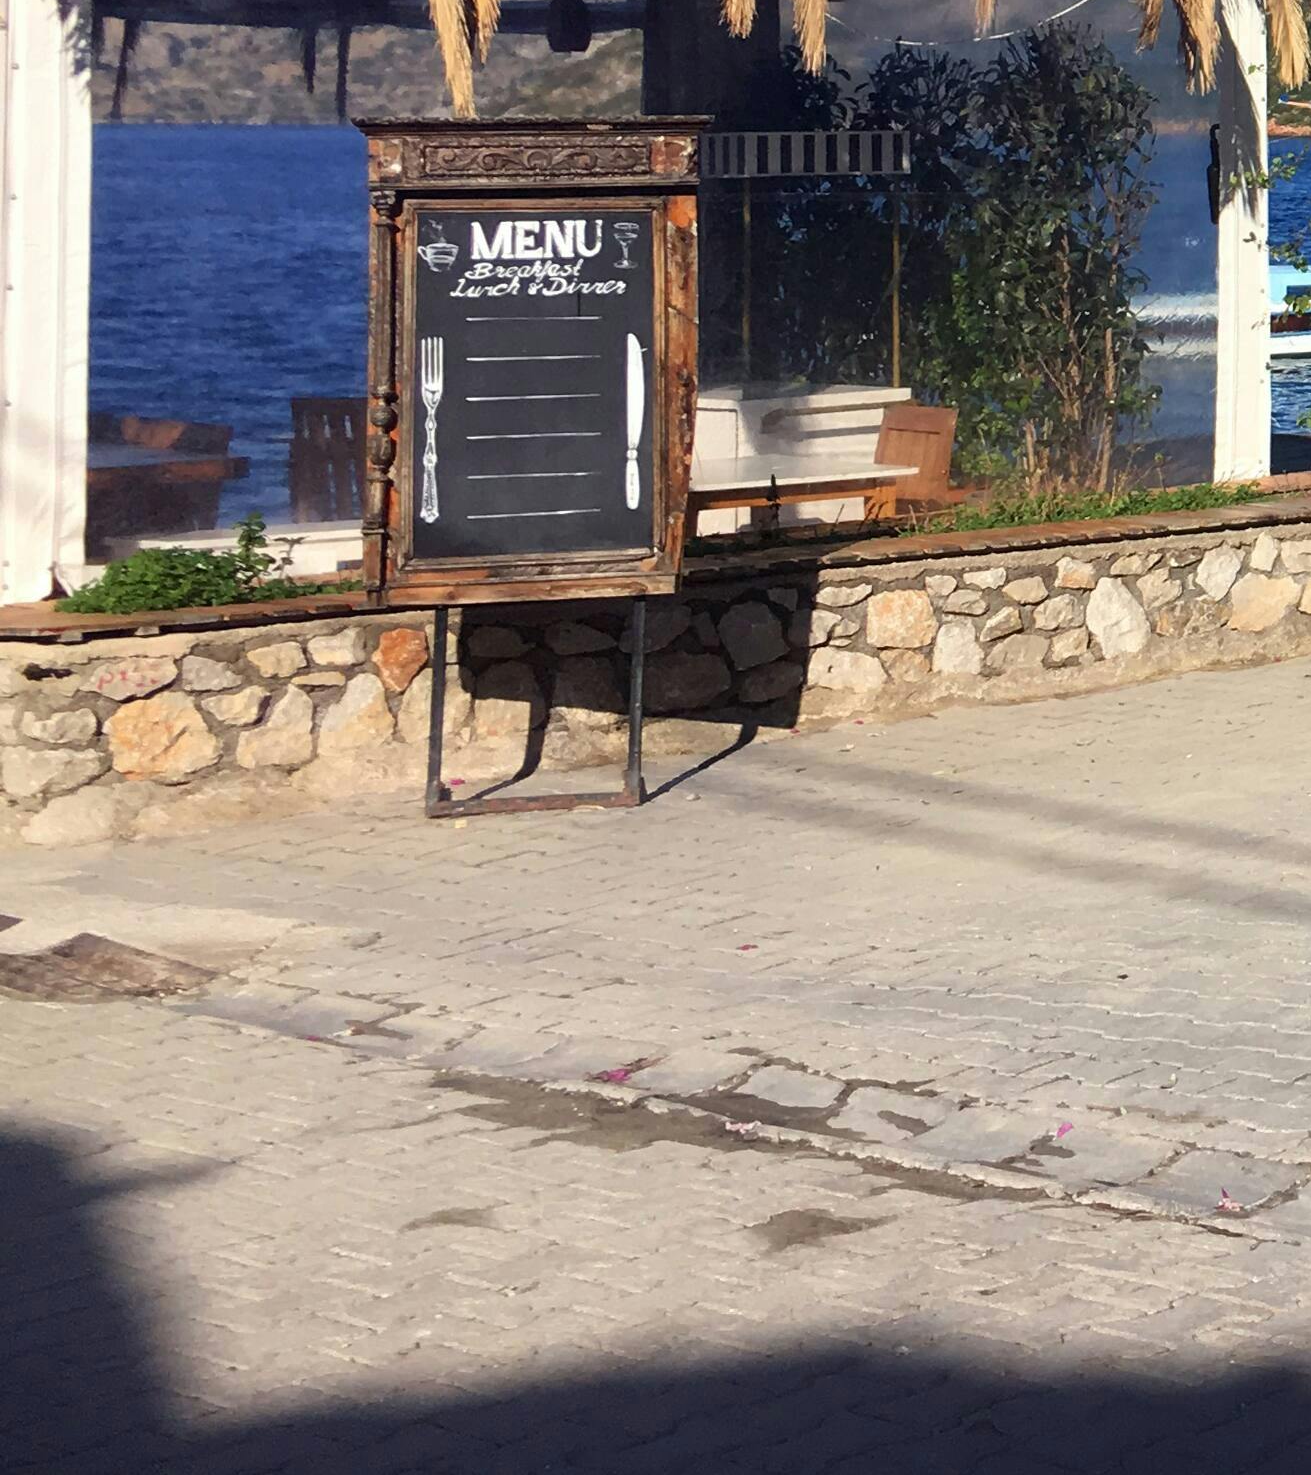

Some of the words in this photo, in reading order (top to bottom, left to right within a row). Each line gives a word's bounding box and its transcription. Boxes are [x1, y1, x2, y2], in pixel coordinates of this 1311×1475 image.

[471, 219, 603, 260] MENU
[464, 259, 584, 283] Breakfast
[450, 276, 521, 298] Lunch
[527, 281, 543, 296] &
[542, 277, 627, 297] Dinner
